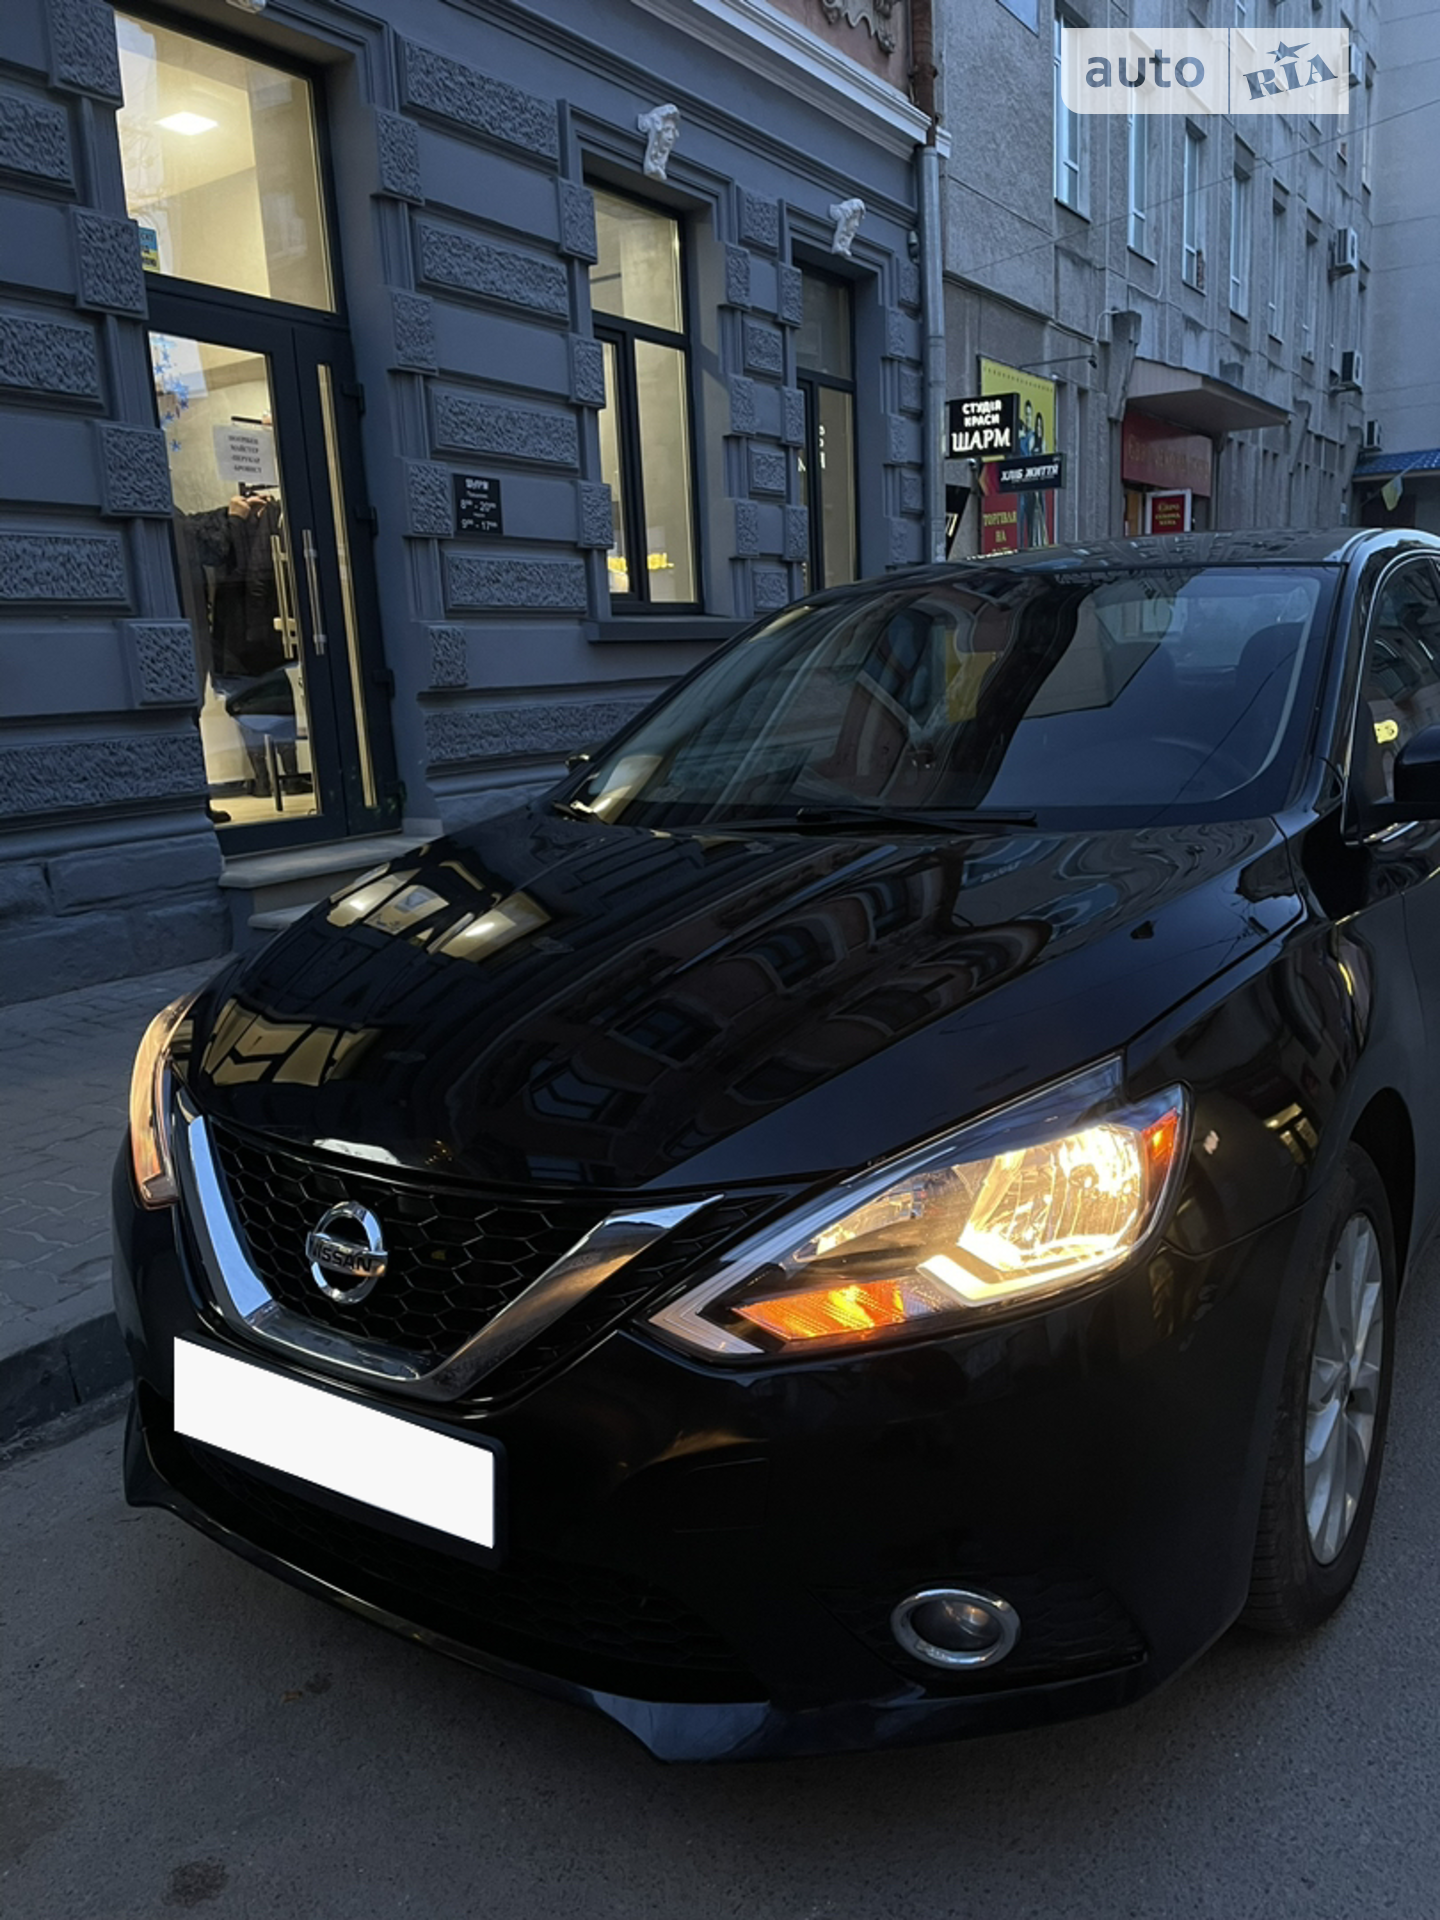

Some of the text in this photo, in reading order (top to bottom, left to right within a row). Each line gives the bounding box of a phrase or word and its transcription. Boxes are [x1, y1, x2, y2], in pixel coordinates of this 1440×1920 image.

[964, 412, 1000, 427] КРАСИ
[951, 427, 1011, 452] ШАРМ
[312, 1243, 371, 1271] NISSAN
